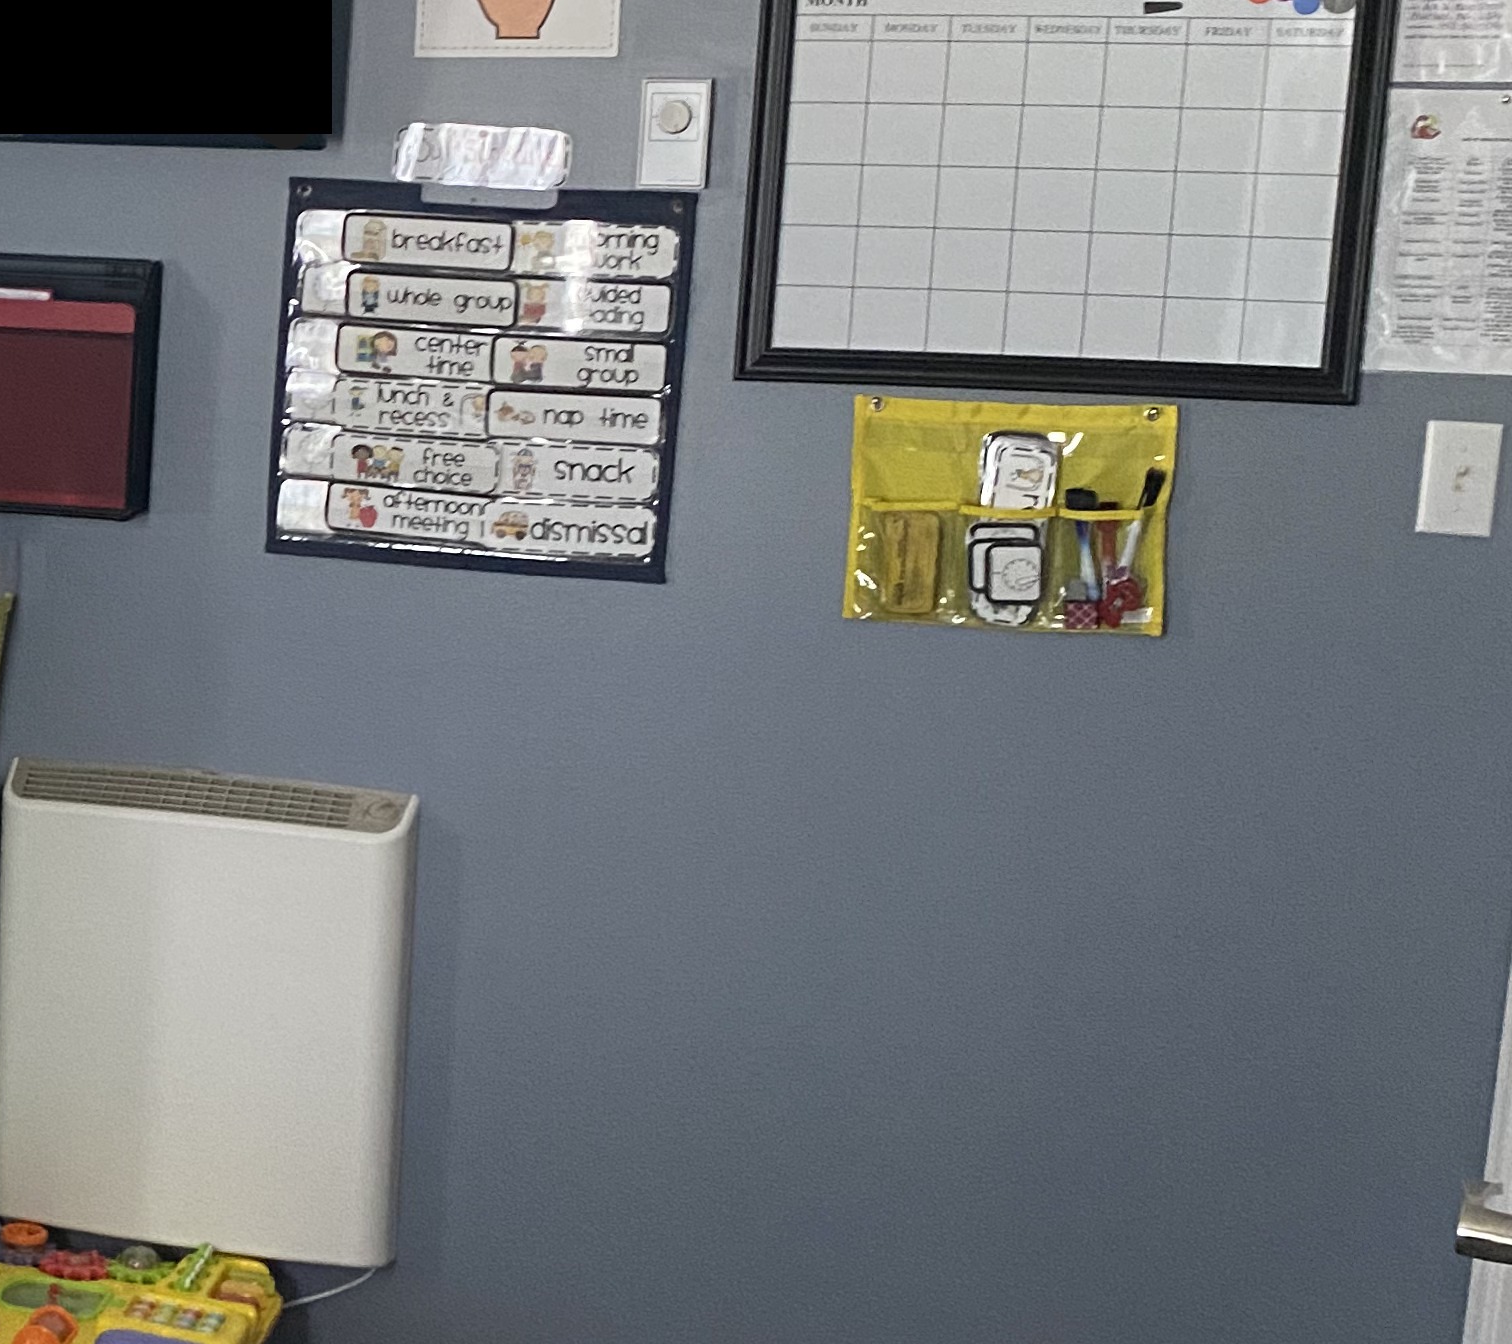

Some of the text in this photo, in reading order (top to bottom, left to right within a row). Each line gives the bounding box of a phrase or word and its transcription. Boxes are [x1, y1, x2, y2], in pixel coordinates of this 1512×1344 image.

[391, 229, 505, 254] breakfast
[596, 230, 660, 255] orning
[387, 287, 513, 314] whole group
[414, 334, 488, 355] center
[584, 343, 635, 363] small
[426, 355, 474, 376] time
[576, 367, 639, 388] group
[375, 382, 430, 406] lunch
[378, 409, 452, 428] recess
[543, 407, 650, 429] nap time
[422, 447, 466, 467] free
[413, 467, 473, 487] choice
[553, 457, 636, 484] snack
[382, 490, 482, 516] afternoon
[392, 512, 470, 541] meeting
[529, 517, 649, 546] dismissal
